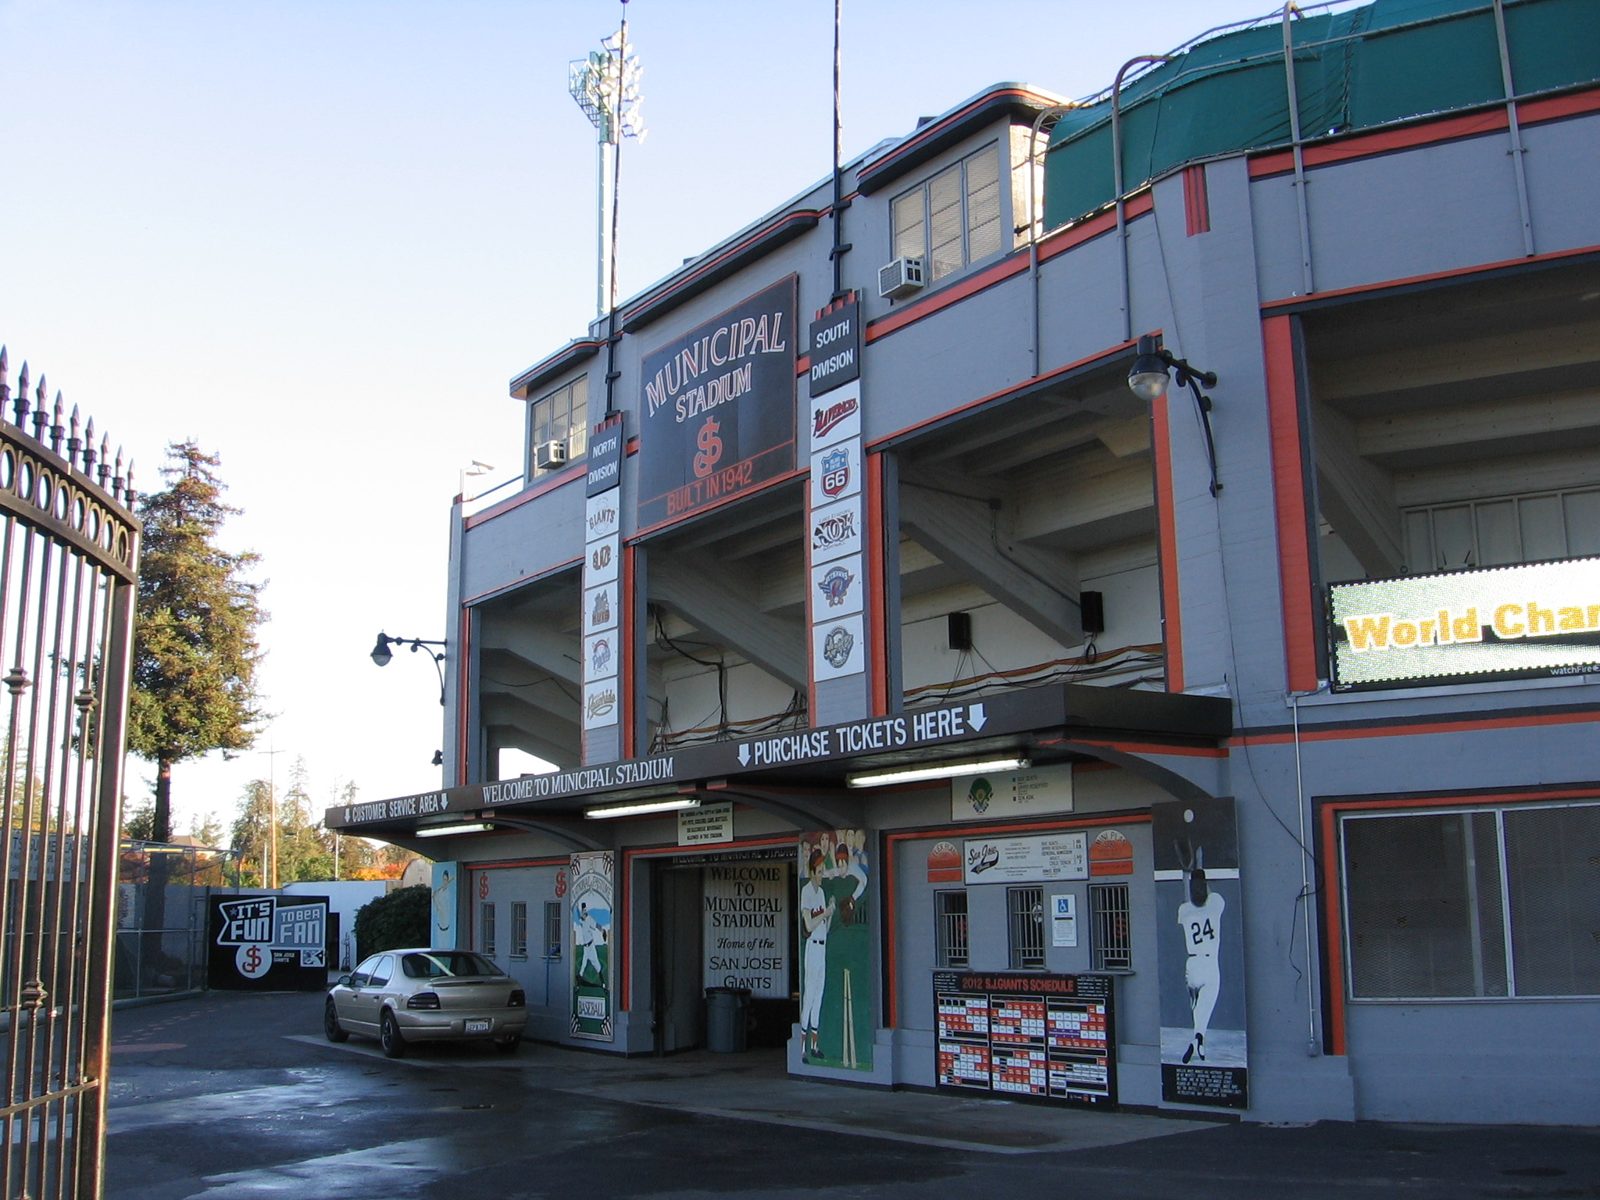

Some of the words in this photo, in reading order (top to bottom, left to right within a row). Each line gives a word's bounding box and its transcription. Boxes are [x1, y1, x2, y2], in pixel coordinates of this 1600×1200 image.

[816, 319, 850, 348] SOUTH
[644, 311, 786, 418] MUNICIPAL
[811, 348, 854, 381] DIVISION
[675, 362, 752, 423] STADIUM
[592, 437, 617, 459] NORTH
[588, 460, 618, 485] DIVISION
[825, 470, 846, 490] 66
[667, 479, 703, 515] BUILT
[705, 475, 720, 498] IN
[720, 461, 752, 492] 1942
[589, 508, 616, 530] GIANTS
[1346, 606, 1479, 650] World
[754, 730, 830, 765] PURCHASE
[835, 717, 907, 752] TICKETS
[912, 706, 965, 742] HERE
[483, 780, 533, 804] WELCOME
[534, 777, 550, 796] TO
[550, 768, 614, 795] MUNICIPAL
[615, 756, 674, 784] STADIUM
[352, 802, 387, 823] CUSTOMER
[389, 797, 416, 818] SERVICE
[419, 794, 439, 813] AREA
[711, 866, 781, 881] WELCOME
[734, 882, 755, 897] TO
[236, 902, 271, 919] IT'S
[704, 896, 783, 912] MUNICIPAL
[230, 917, 270, 940] FUN
[712, 911, 776, 928] STADIUM
[279, 920, 320, 944] FAN
[1190, 918, 1215, 945] 24
[716, 938, 746, 949] Home
[746, 938, 758, 951] of
[758, 938, 775, 949] the
[709, 956, 739, 970] SAN
[741, 956, 782, 970] JOSE
[723, 975, 772, 989] GIANTS
[962, 976, 983, 990] 2012
[1029, 978, 1074, 993] SCHEDULE
[578, 999, 605, 1018] BASEBALL
